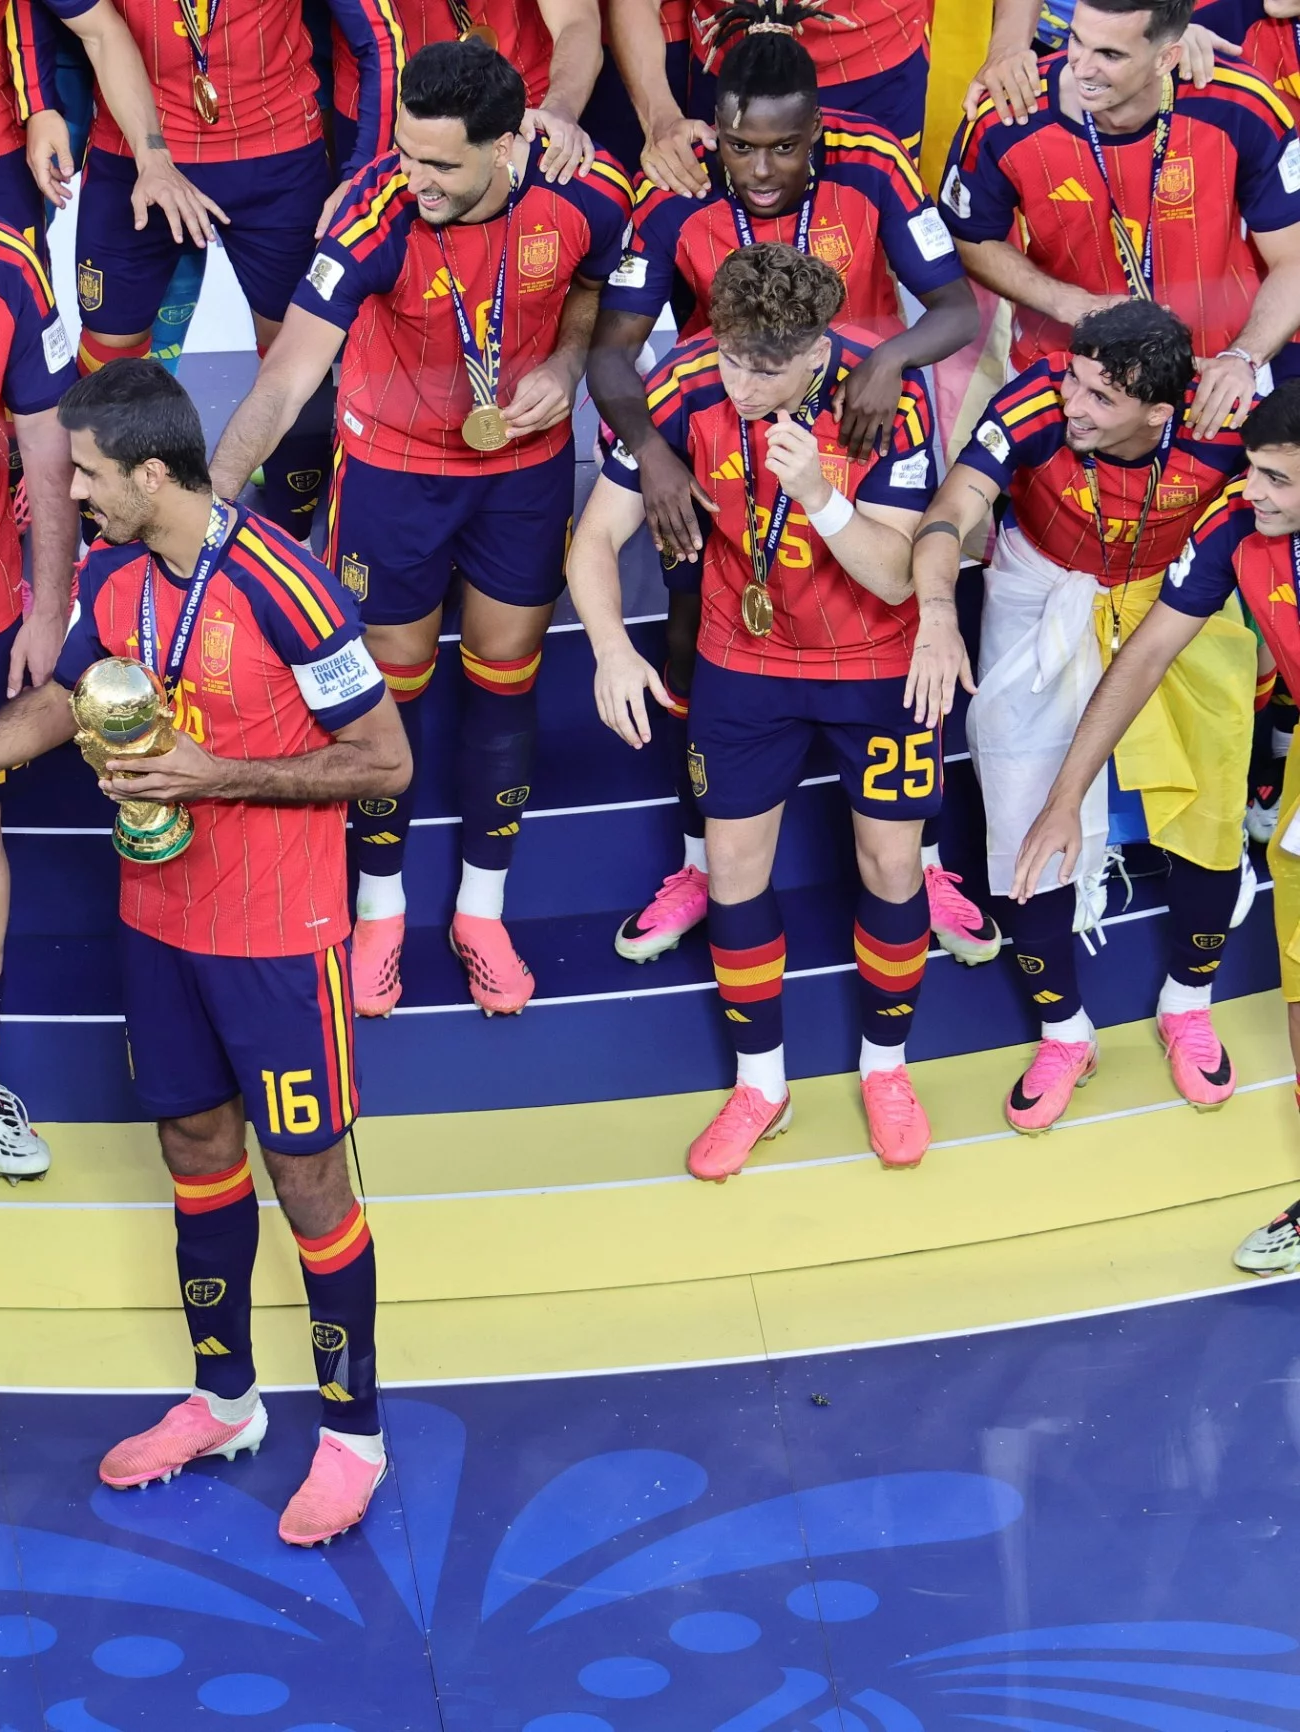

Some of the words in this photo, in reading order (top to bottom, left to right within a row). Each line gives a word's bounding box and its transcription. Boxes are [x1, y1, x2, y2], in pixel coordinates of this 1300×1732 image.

[736, 208, 748, 230] FIFA
[799, 200, 810, 235] 2026
[493, 298, 502, 319] FIFA
[457, 309, 471, 344] 2026
[767, 530, 779, 549] FIFA
[773, 495, 788, 531] WORLD
[196, 559, 211, 581] FIFA
[142, 578, 151, 616] WORLD
[185, 580, 204, 617] WORLD
[142, 616, 152, 639] CUP
[180, 615, 193, 636] CUP
[171, 635, 187, 667] 2026
[311, 650, 355, 675] FOOTBALL
[314, 657, 360, 685] UNITES
[317, 684, 339, 695] the
[337, 665, 370, 688] World
[863, 730, 935, 802] 25
[261, 1069, 320, 1135] 16
